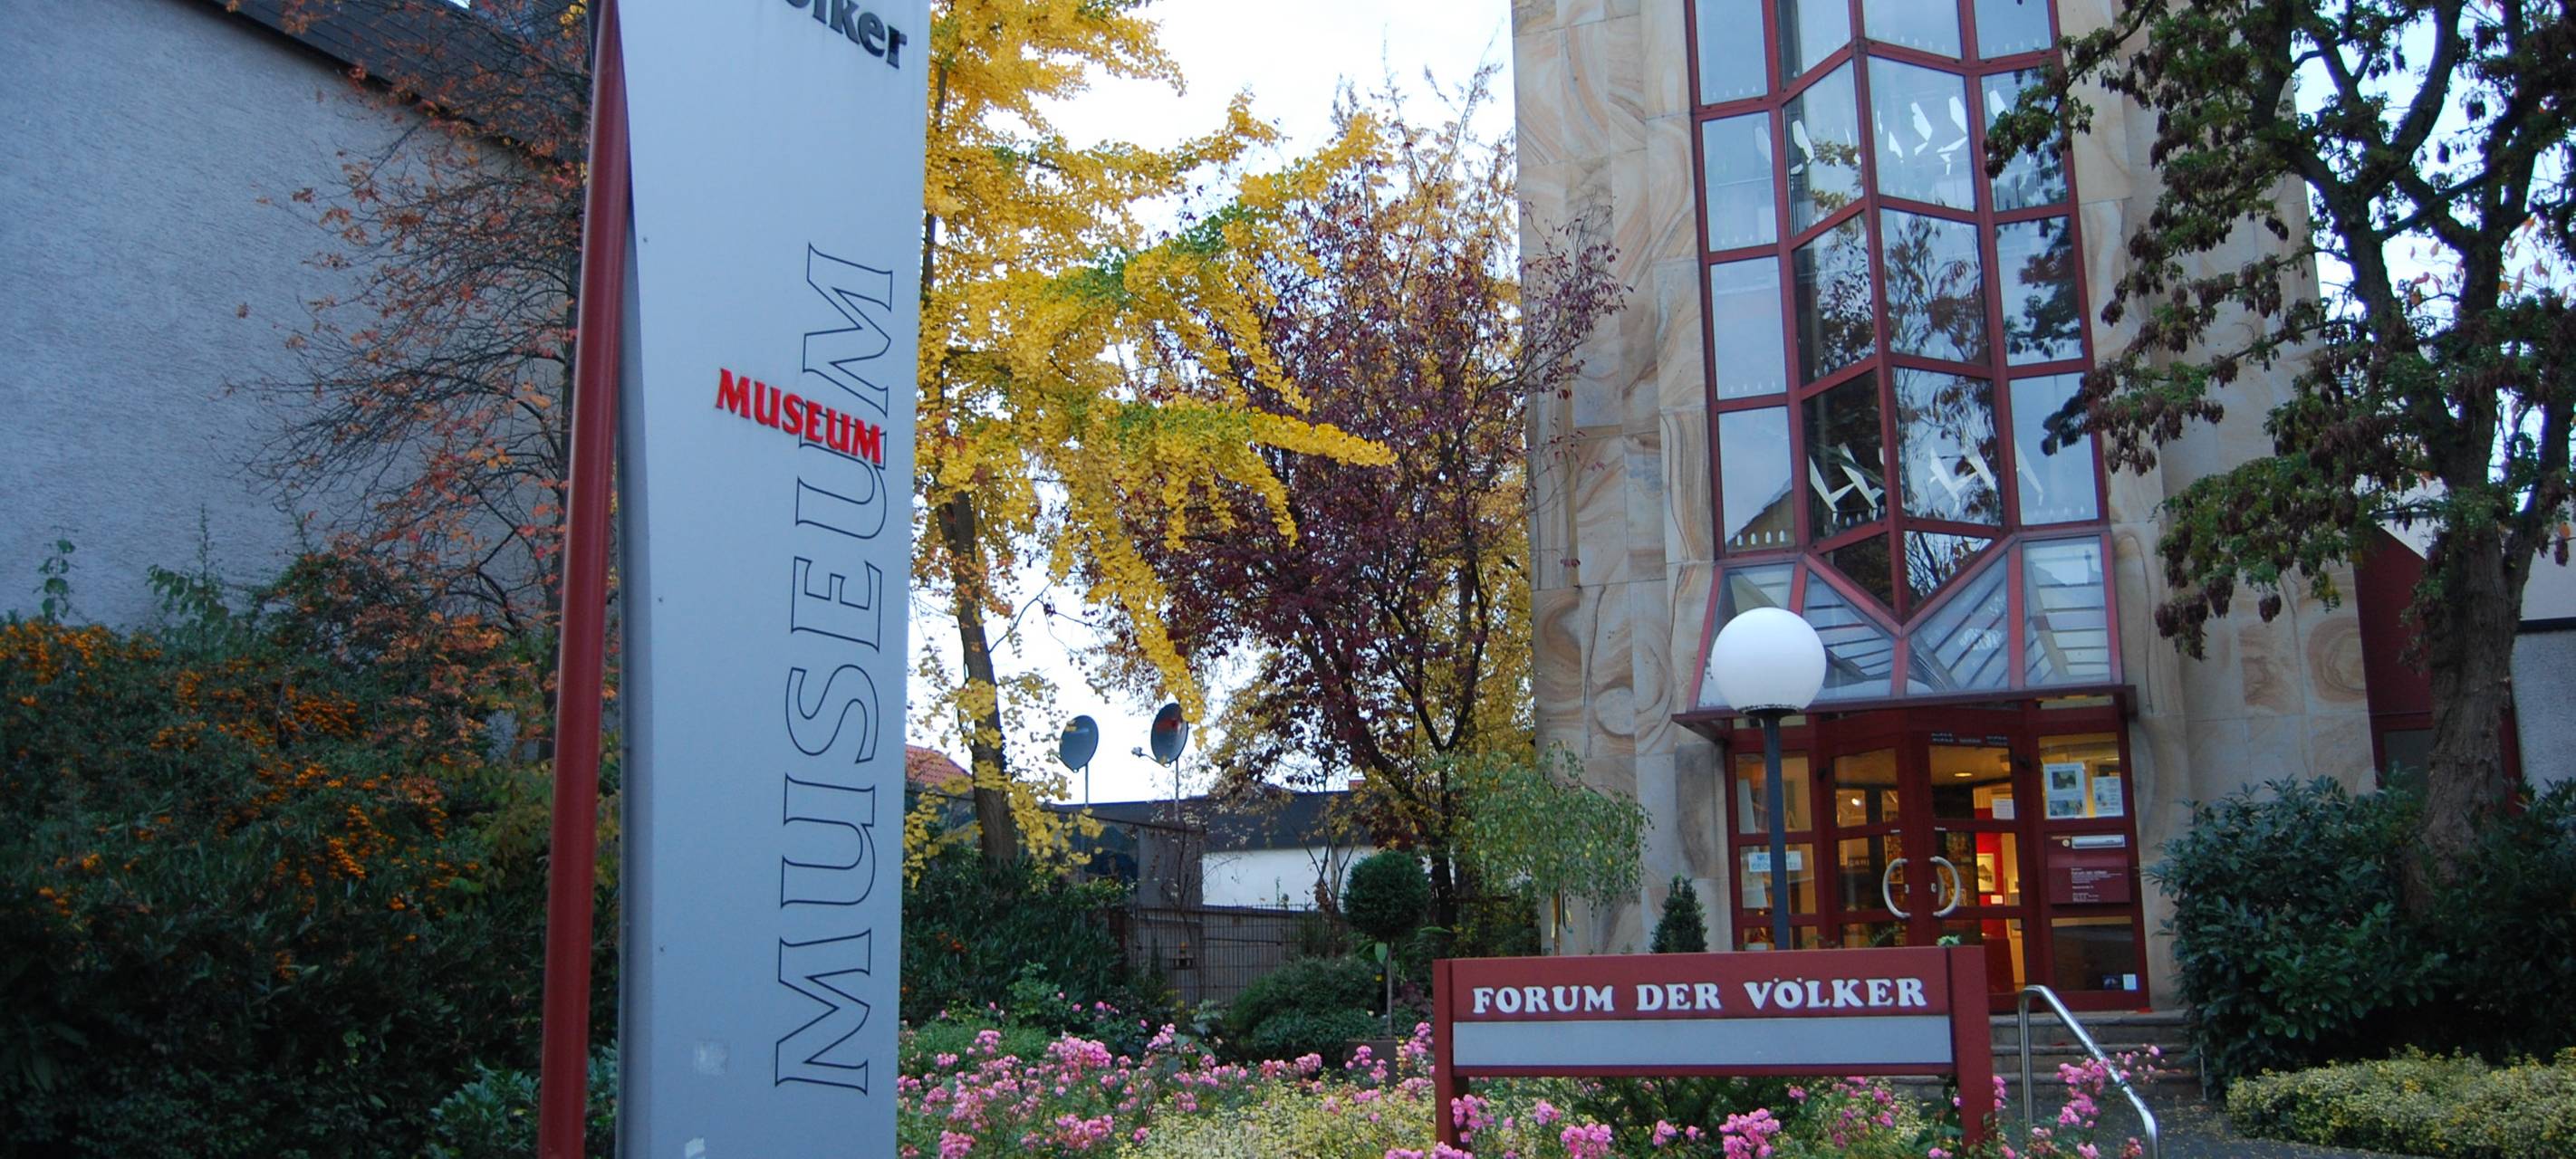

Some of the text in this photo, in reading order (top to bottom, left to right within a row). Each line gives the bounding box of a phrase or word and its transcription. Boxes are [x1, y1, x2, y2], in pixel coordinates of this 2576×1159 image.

[784, 0, 908, 70] ker
[715, 367, 882, 465] MUSEUM
[774, 241, 893, 1096] MUSEUM
[1472, 977, 1927, 1014] FORUM DER VÖLKER
